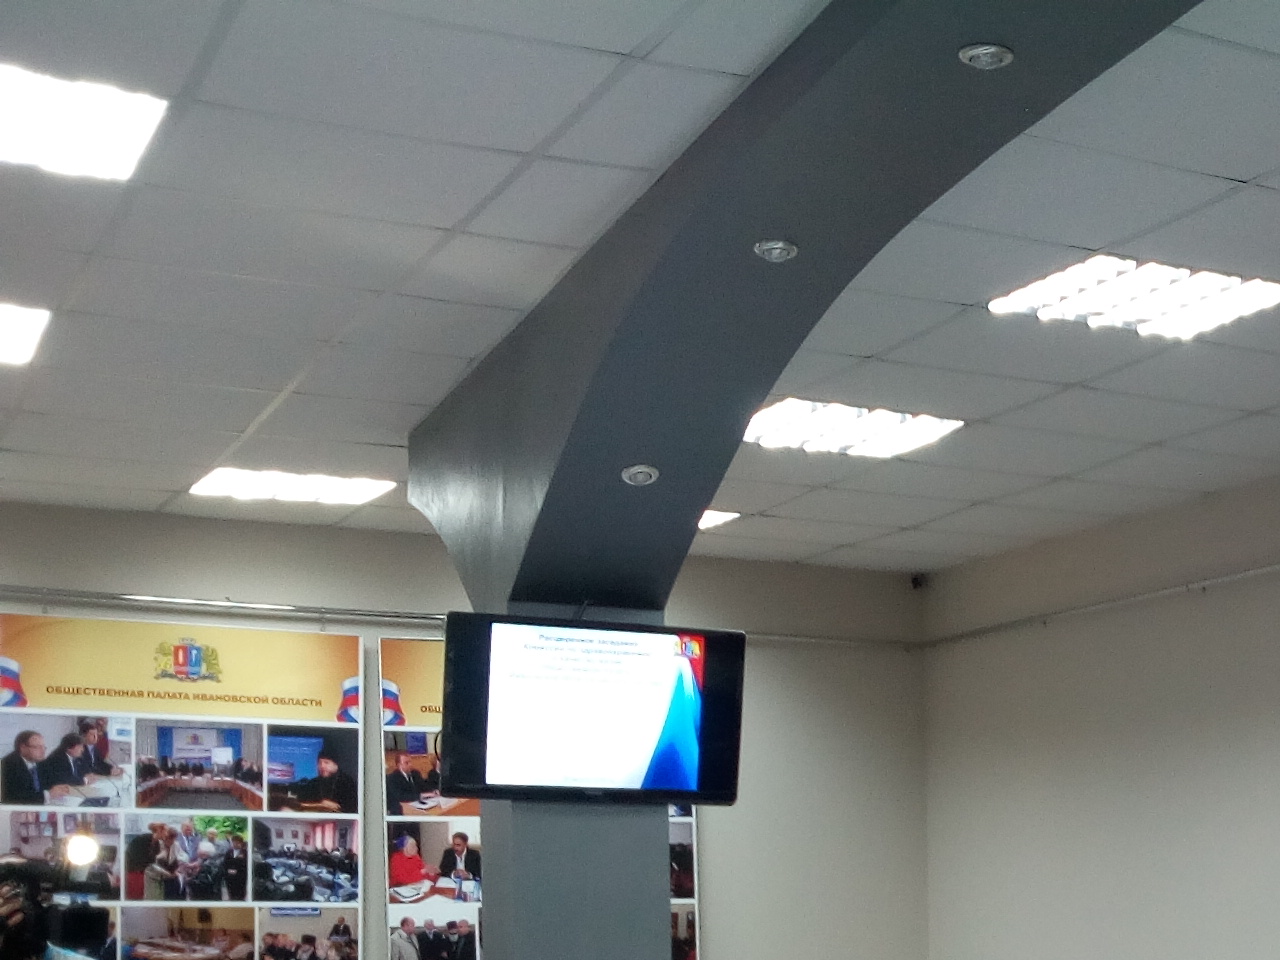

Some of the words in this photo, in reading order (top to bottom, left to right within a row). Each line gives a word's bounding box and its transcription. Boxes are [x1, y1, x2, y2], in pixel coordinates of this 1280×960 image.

[46, 685, 144, 698] ОБЩЕСТВЕННАЯ
[147, 690, 190, 701] ПАЛАТА
[192, 693, 270, 704] ИВАНОВСКОЙ
[271, 696, 323, 708] ОБЛАСТИ
